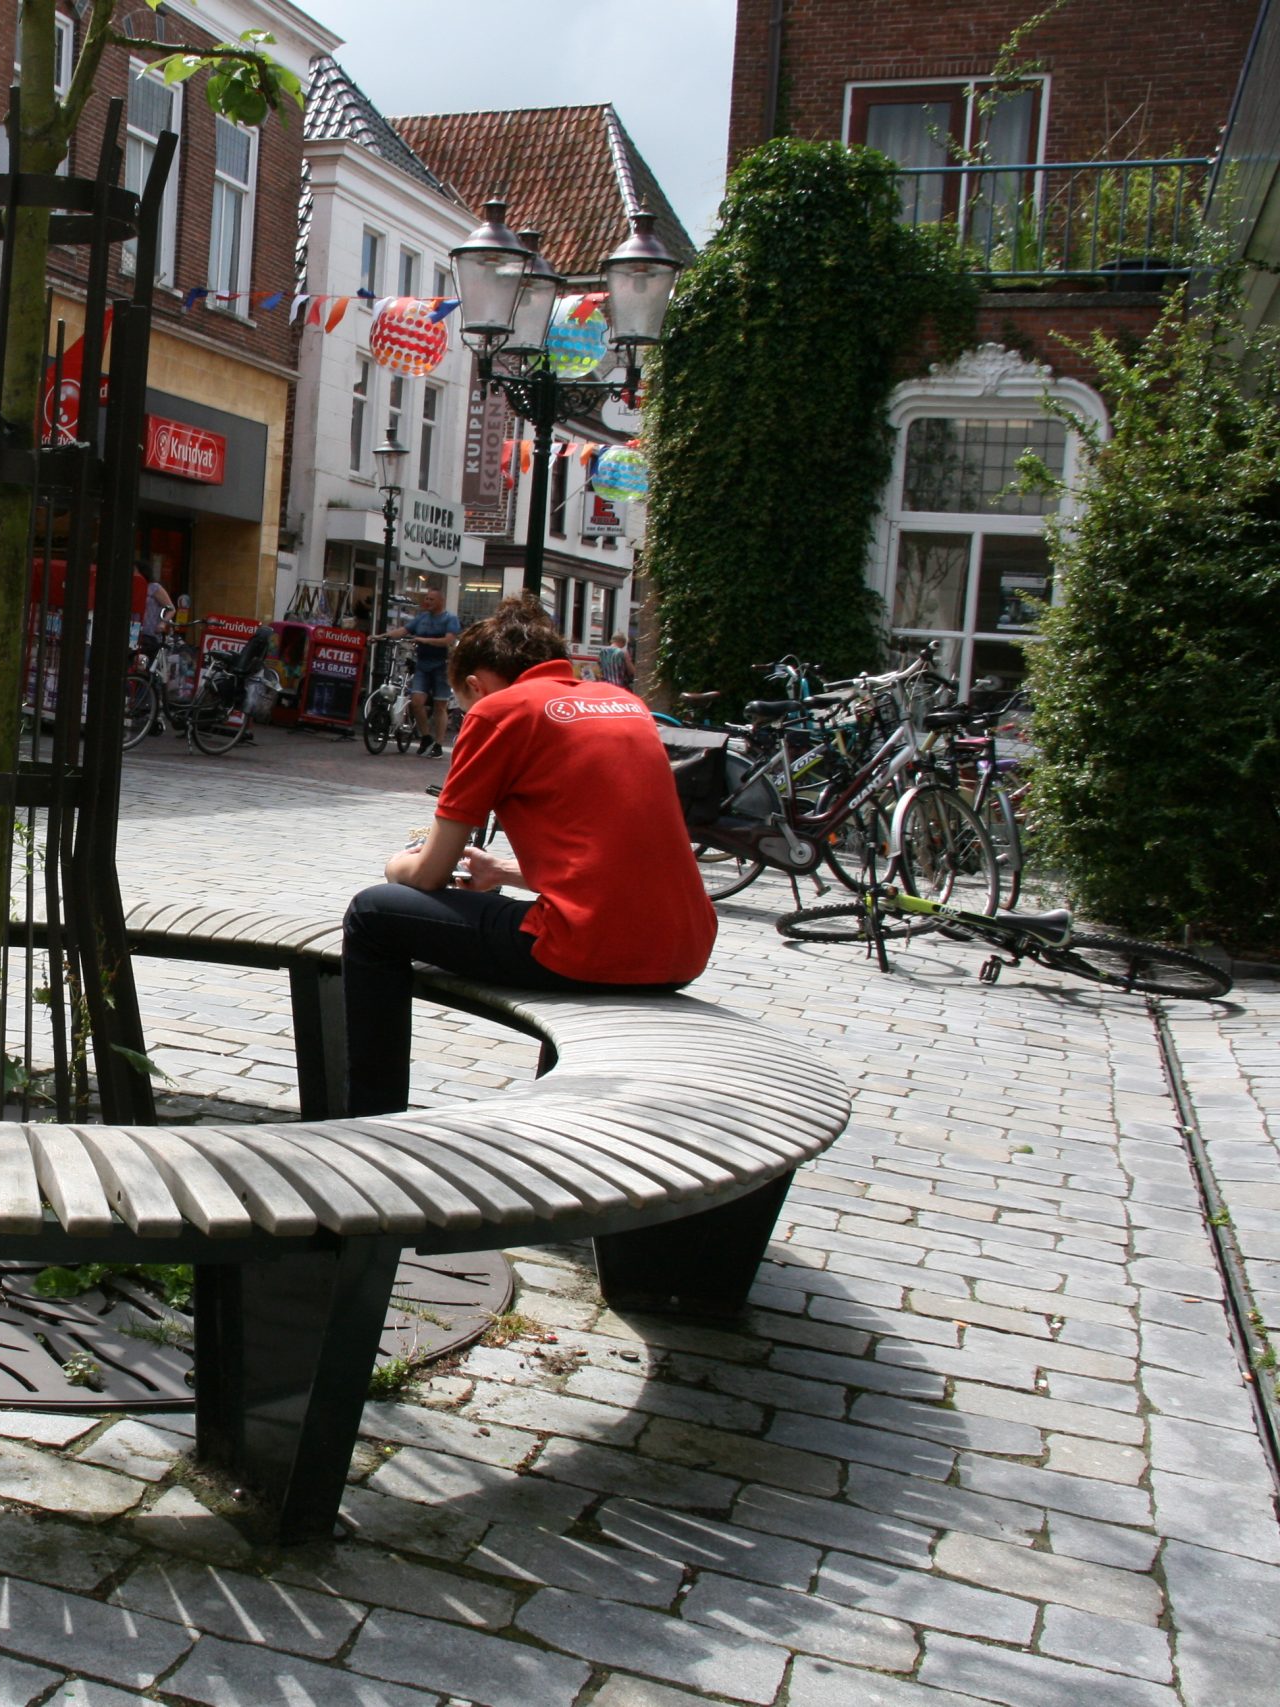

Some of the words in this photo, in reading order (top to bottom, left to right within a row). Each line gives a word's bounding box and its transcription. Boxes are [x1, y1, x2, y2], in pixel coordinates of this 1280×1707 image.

[170, 436, 213, 468] Kruidvat
[414, 501, 454, 529] KUIPER
[325, 630, 361, 645] Kruidvat
[318, 647, 354, 664] ACTIE!
[312, 660, 326, 671] 1+1
[327, 663, 357, 676] GRATIS
[848, 771, 885, 810] GIANT
